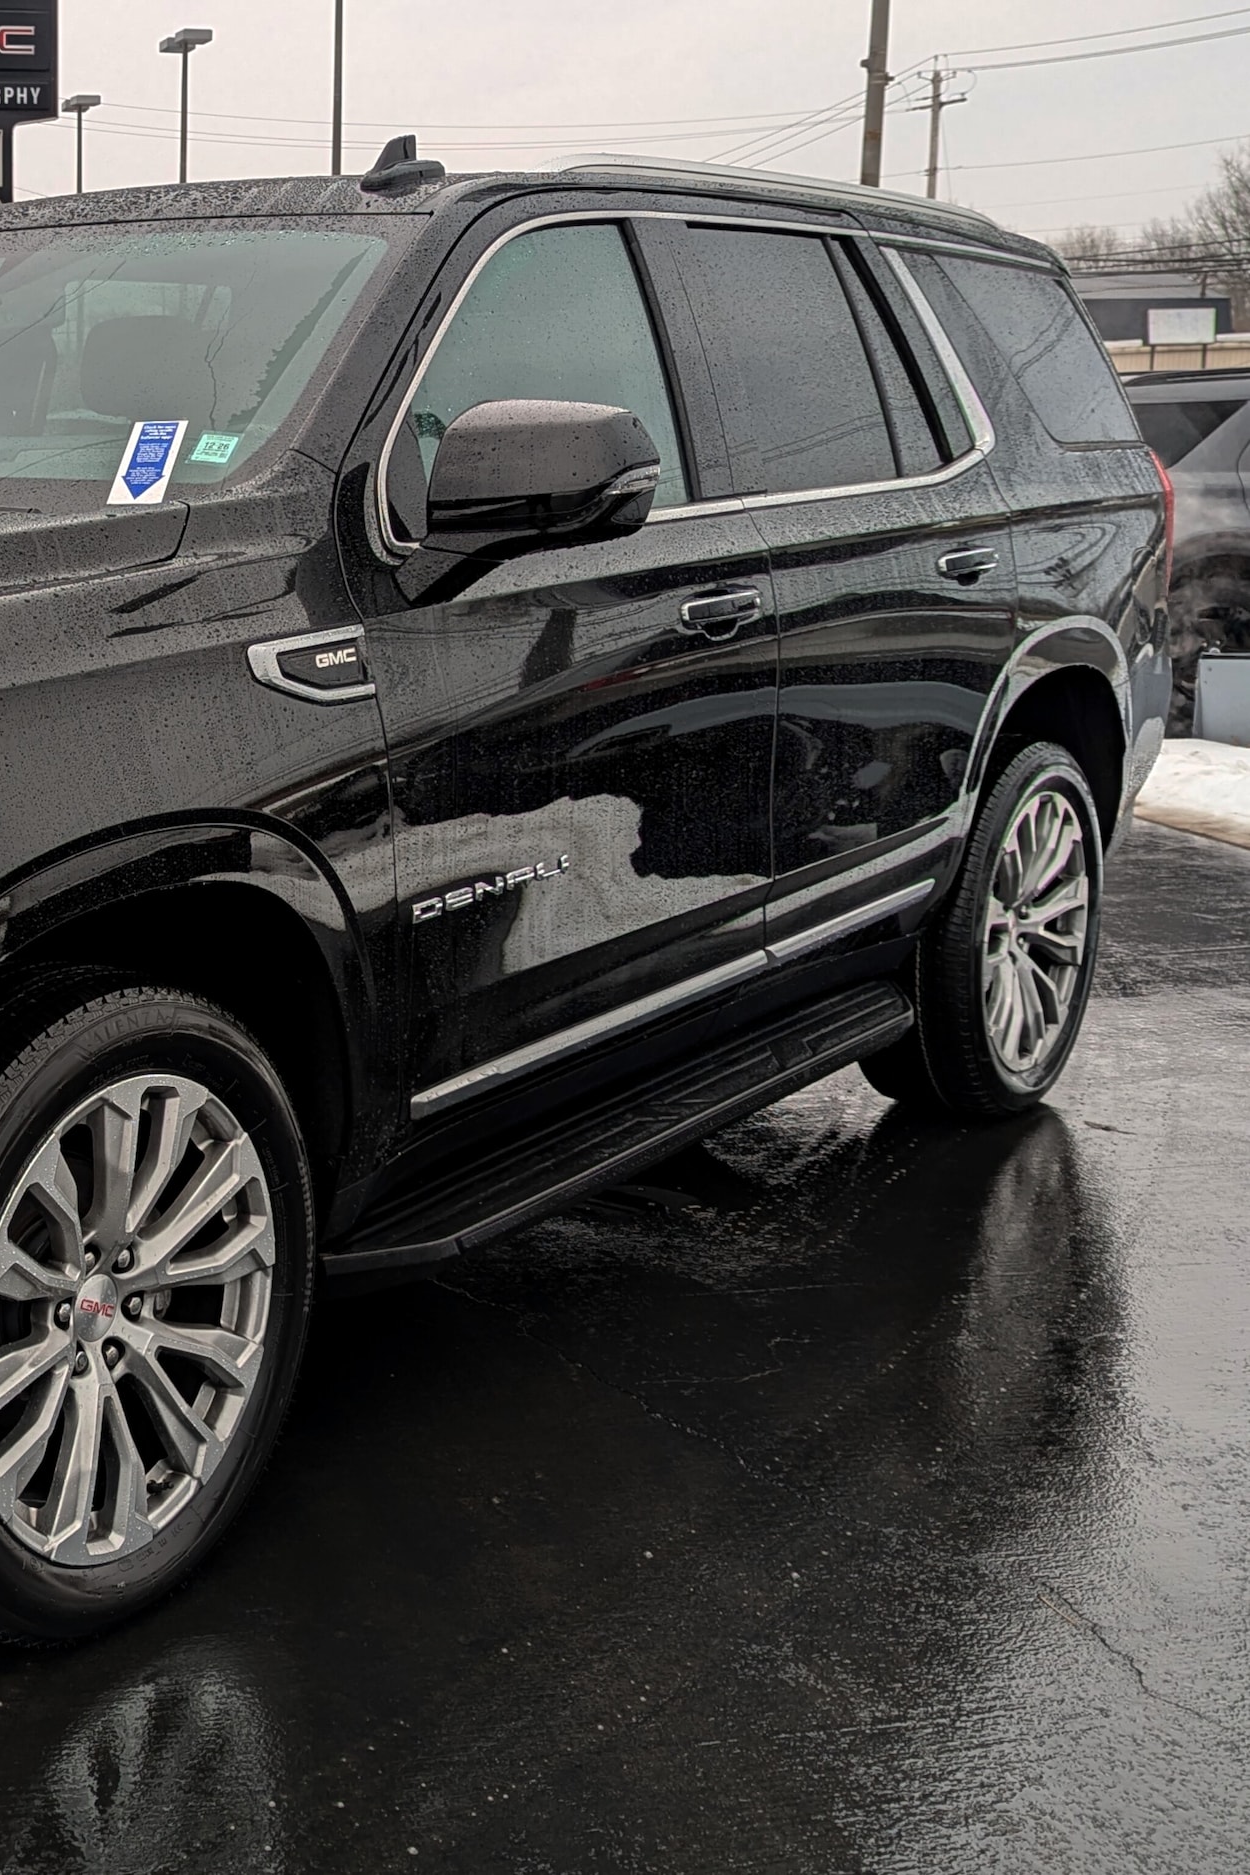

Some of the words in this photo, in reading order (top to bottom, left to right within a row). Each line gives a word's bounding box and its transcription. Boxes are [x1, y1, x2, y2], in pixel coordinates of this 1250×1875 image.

[315, 647, 357, 668] GMC
[412, 854, 570, 924] DENALI
[80, 1299, 115, 1318] GMC
